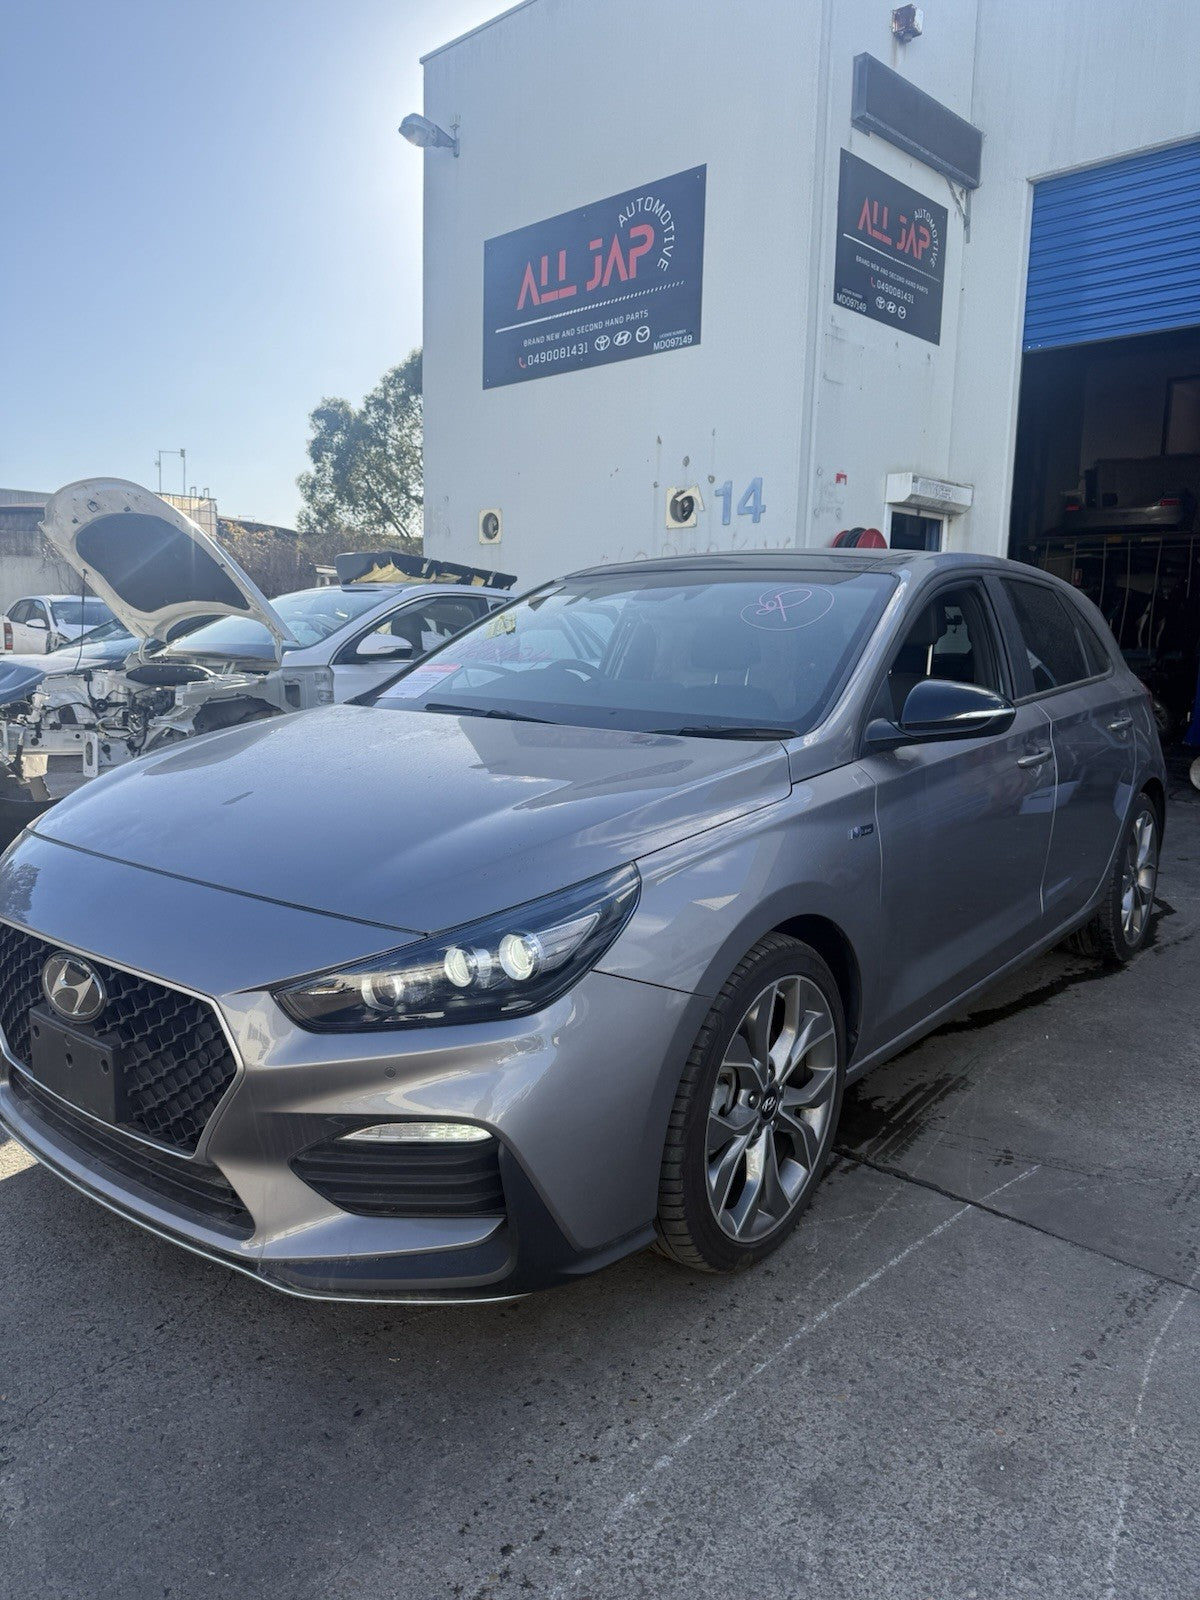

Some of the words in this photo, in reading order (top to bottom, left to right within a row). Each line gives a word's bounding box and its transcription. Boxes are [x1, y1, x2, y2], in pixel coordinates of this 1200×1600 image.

[617, 196, 675, 272] AUTOMOTIVE
[857, 197, 892, 246] ALL
[896, 214, 931, 260] JAP
[914, 208, 939, 268] AUTOMOTIVE
[516, 250, 577, 310] ALL
[586, 223, 655, 291] JAP
[856, 255, 870, 267] BRAND
[870, 262, 880, 272] NEW
[880, 268, 888, 277] AND
[888, 271, 905, 284] SECOND
[905, 279, 916, 289] HAND
[916, 284, 929, 295] PARTS
[876, 280, 914, 304] 0490081431
[523, 336, 545, 347] BRAND
[546, 332, 560, 342] NEW
[561, 328, 576, 338] AND
[576, 321, 604, 335] SECOND
[604, 316, 624, 327] HAND
[625, 309, 649, 322] PARTS
[653, 334, 693, 351] MD097149
[527, 342, 589, 366] 0490081431
[714, 477, 767, 526] 14
